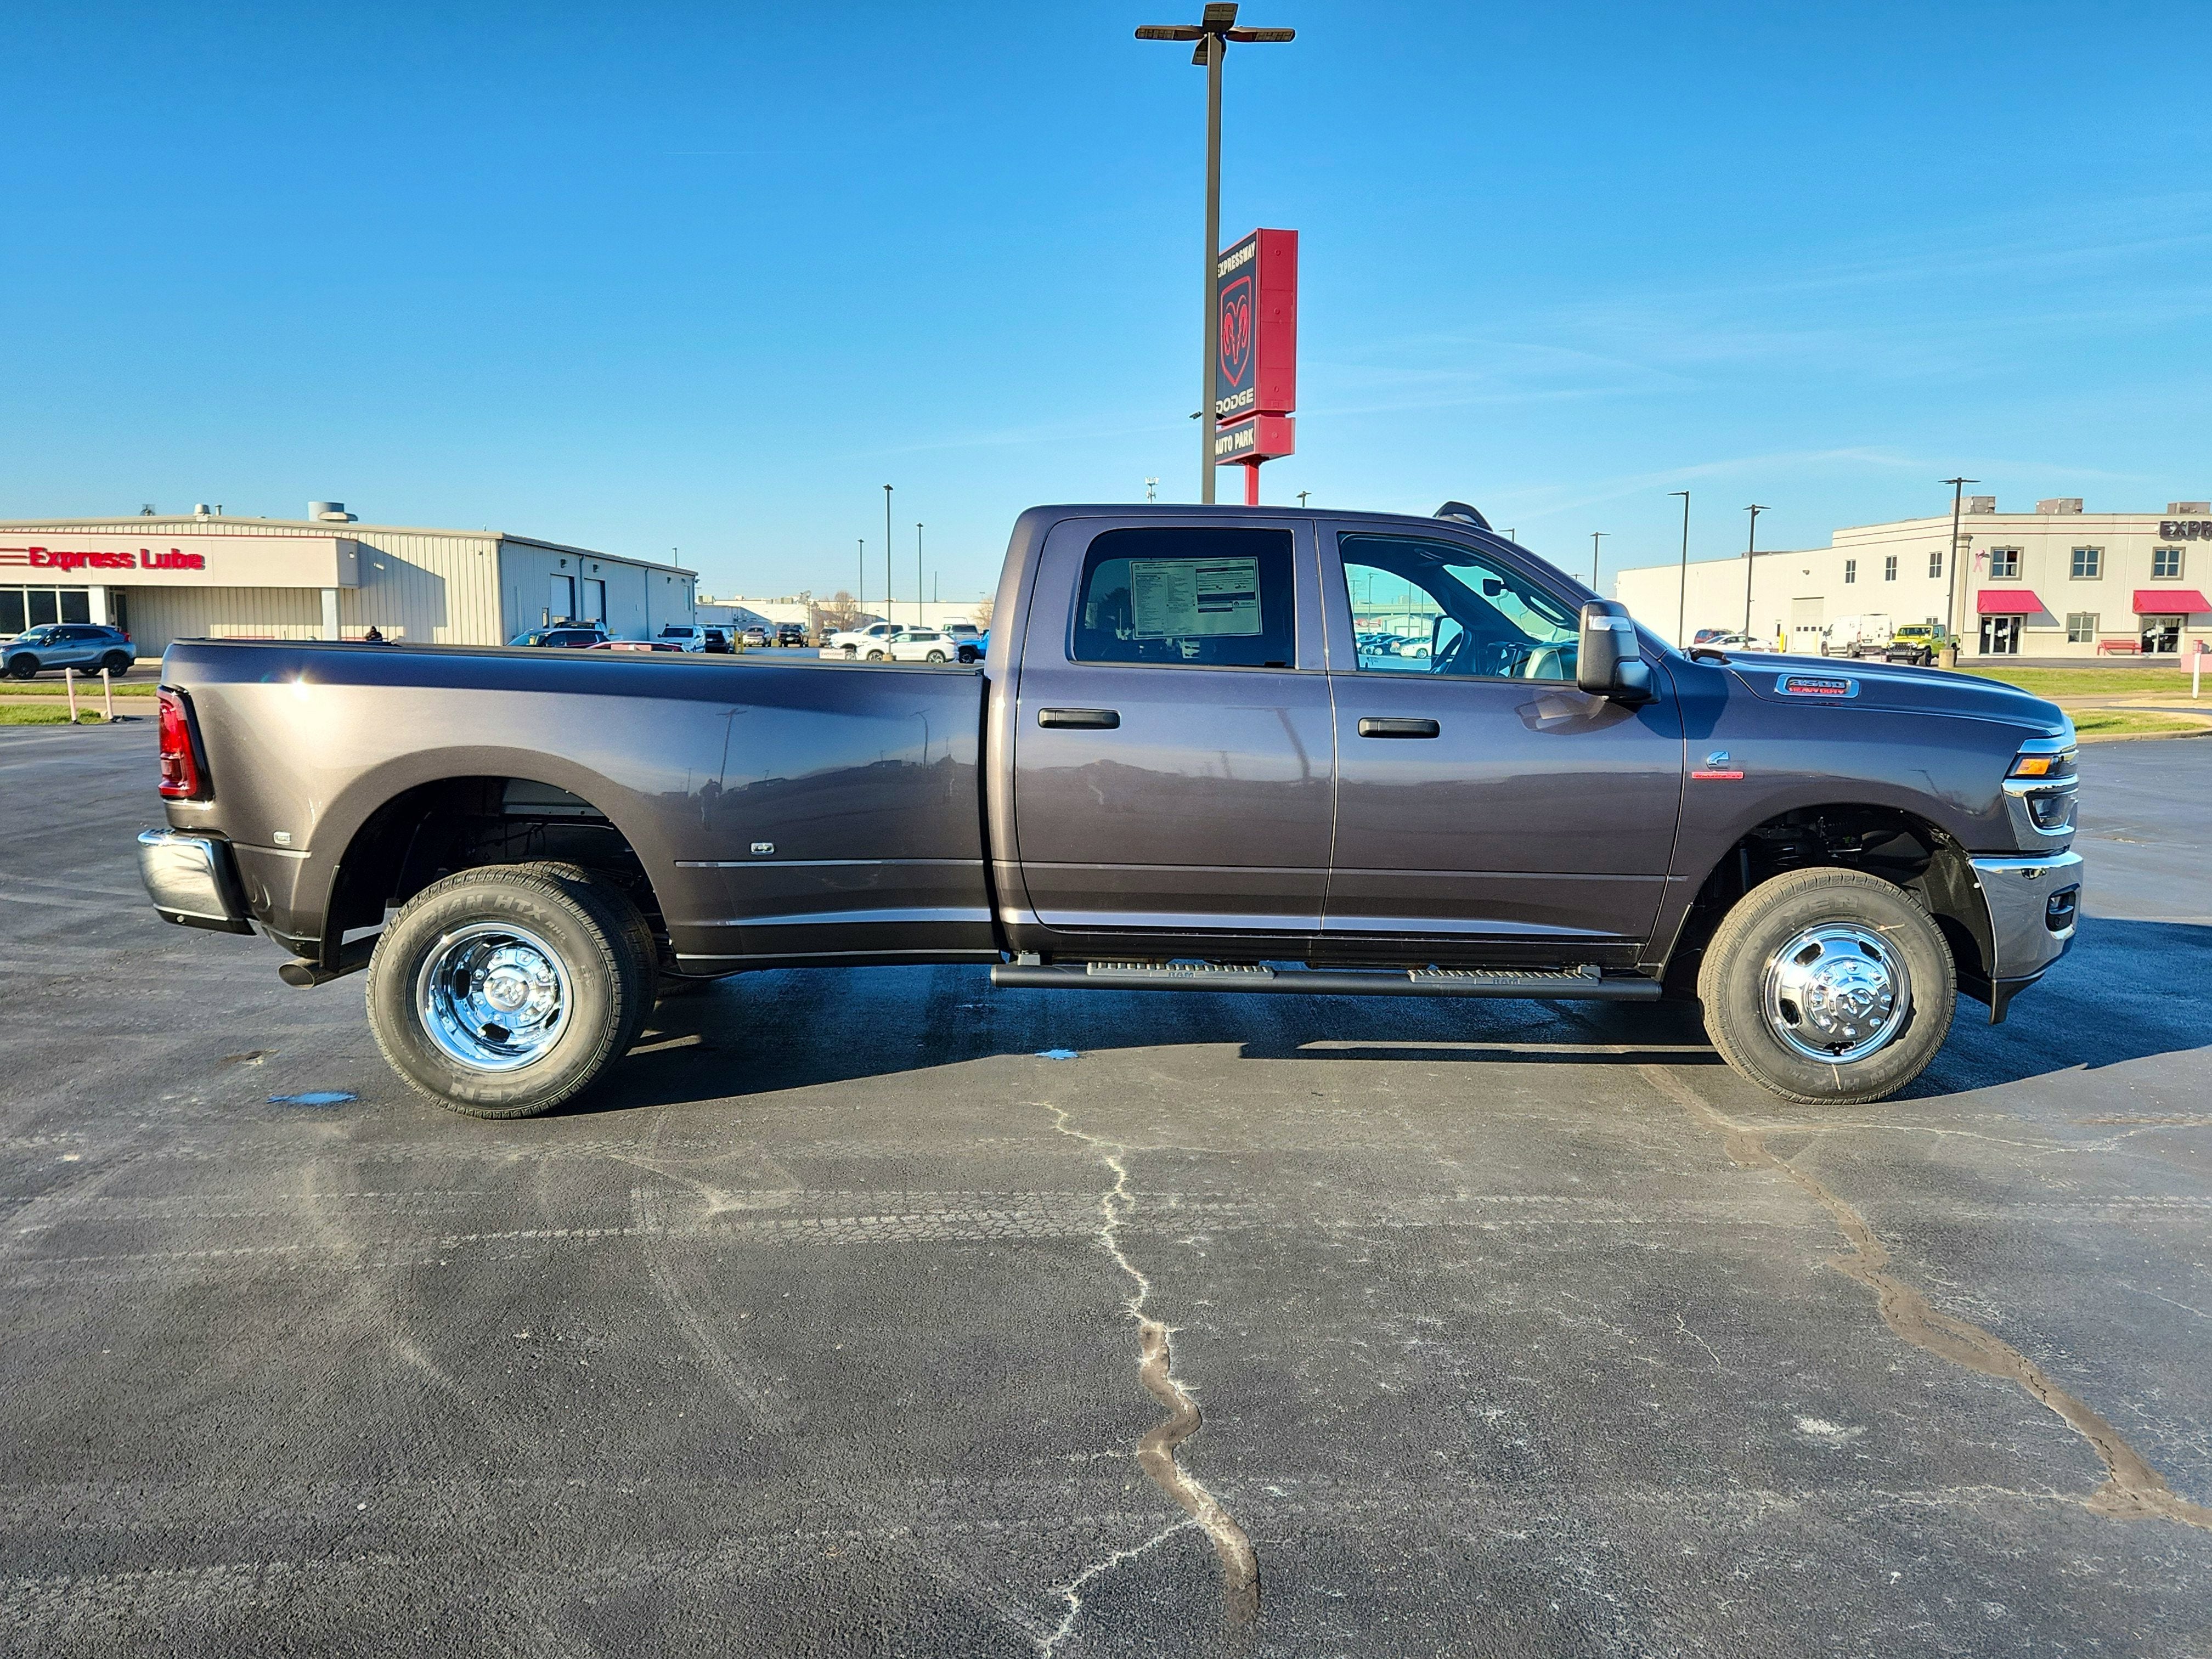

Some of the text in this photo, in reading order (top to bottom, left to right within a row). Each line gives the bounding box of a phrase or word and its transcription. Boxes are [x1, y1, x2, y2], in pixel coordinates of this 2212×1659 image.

[1216, 387, 1254, 414] DODGE
[1215, 427, 1254, 455] AUTO PARK
[2159, 521, 2212, 537] EXPR
[29, 547, 205, 572] Express Lube
[1788, 679, 1846, 689] 3500
[494, 895, 548, 921] HTX
